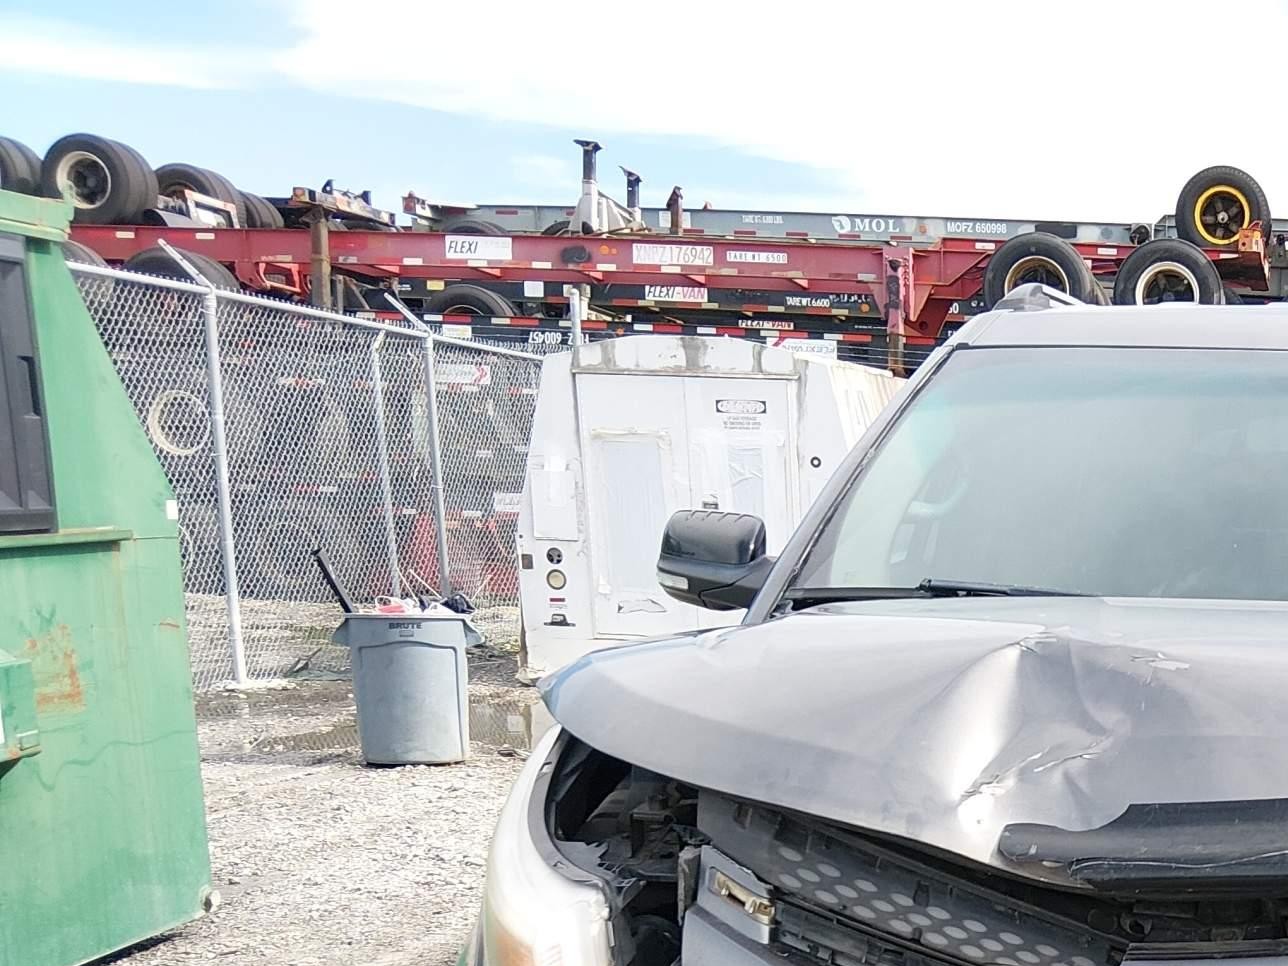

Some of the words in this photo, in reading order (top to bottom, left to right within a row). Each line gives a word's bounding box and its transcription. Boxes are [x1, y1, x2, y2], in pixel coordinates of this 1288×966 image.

[855, 218, 899, 232] MOL
[947, 221, 973, 233] MOFZ
[975, 222, 1007, 234] 650998
[448, 239, 478, 254] FLEXI
[388, 622, 423, 630] BRUTE
